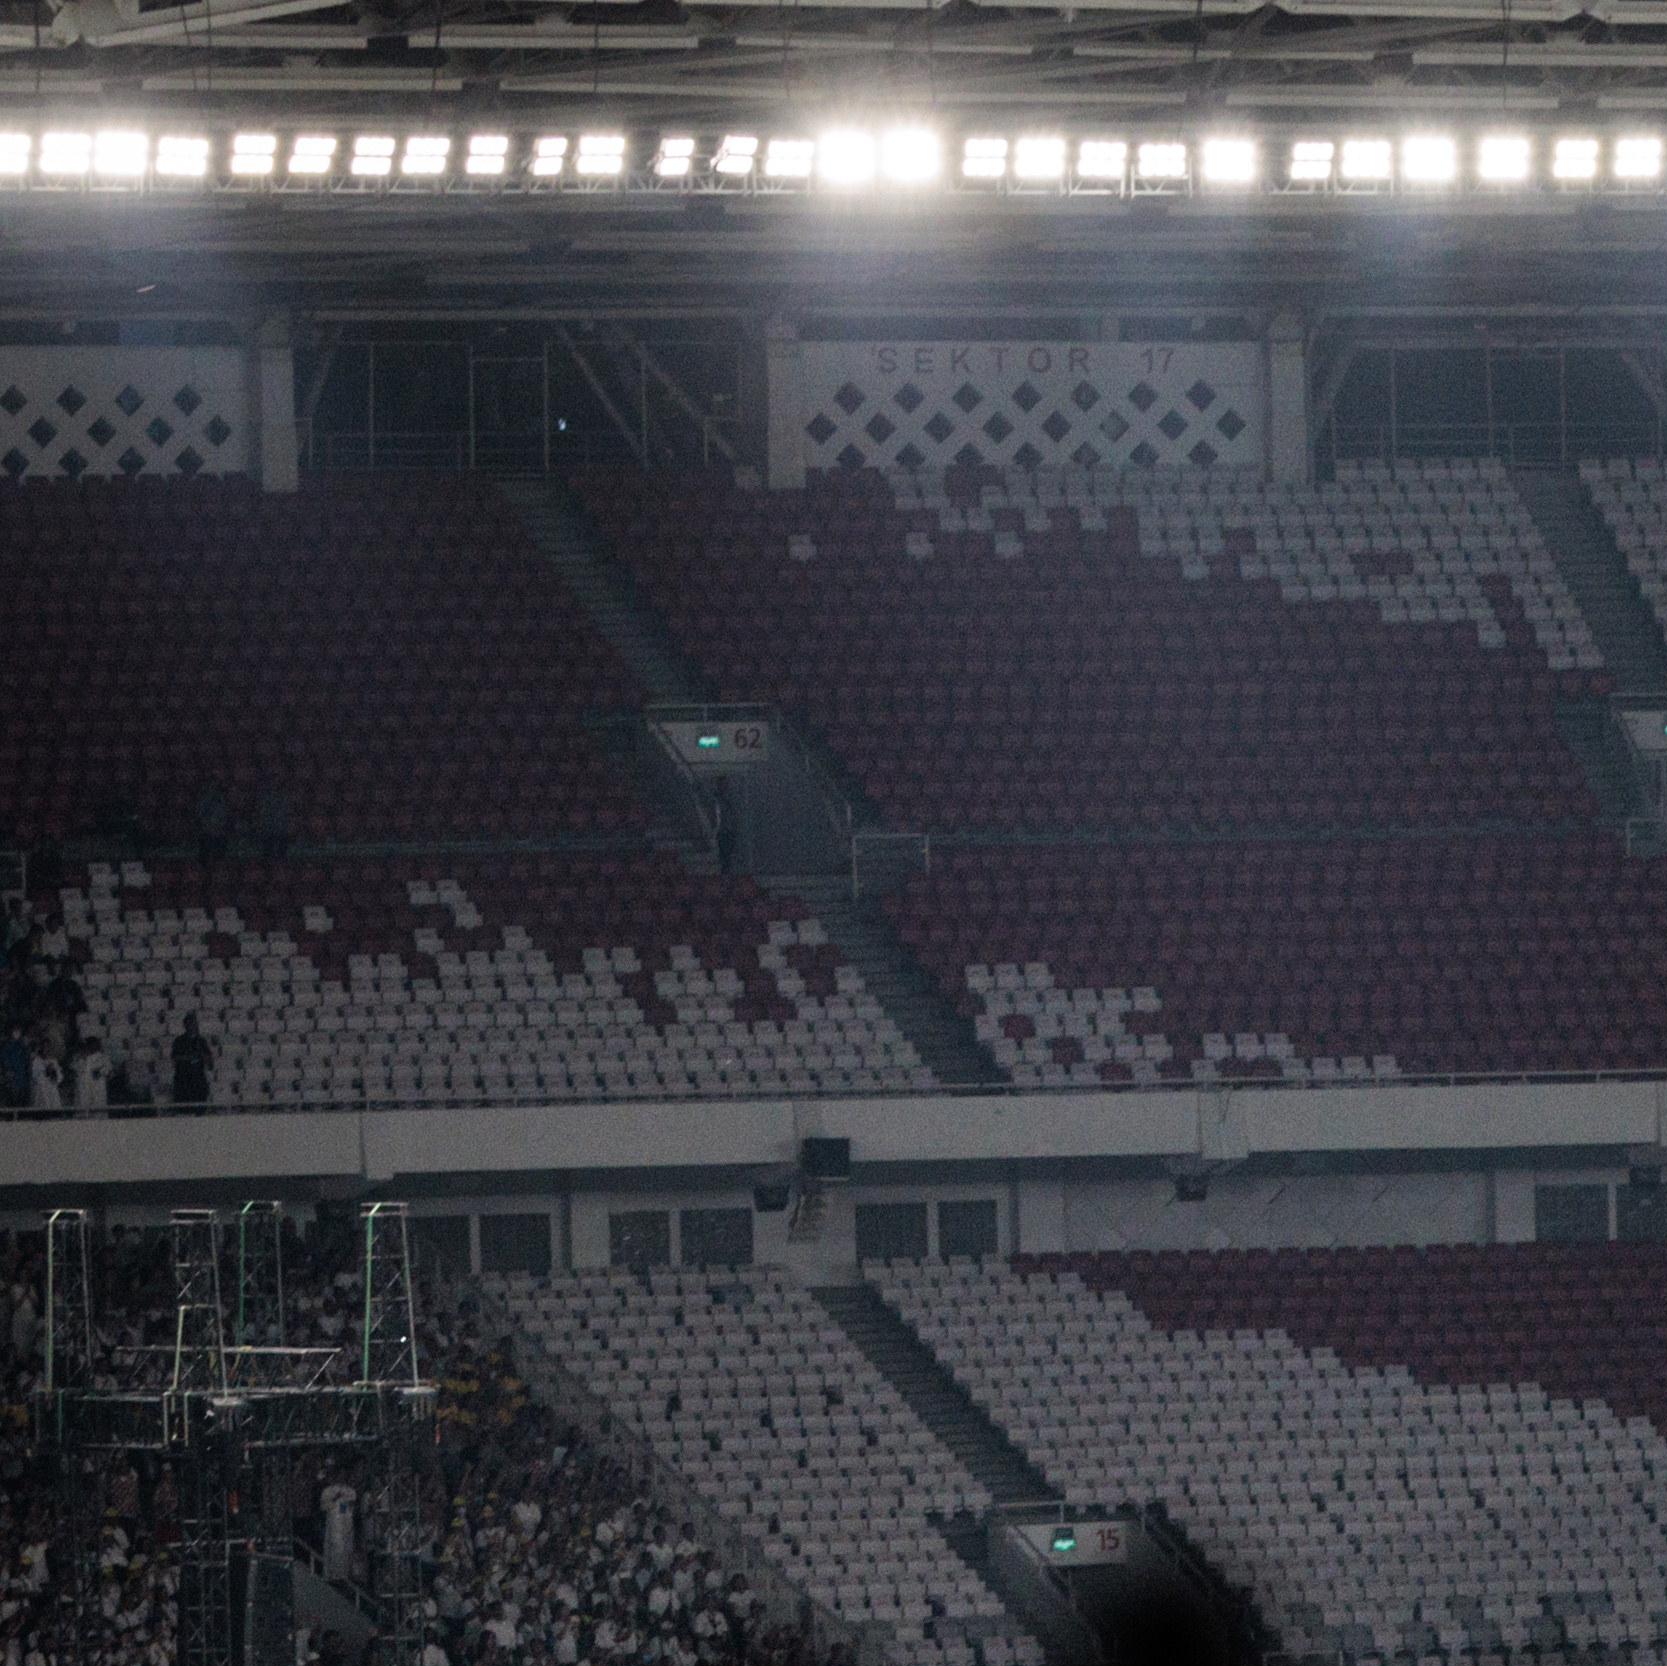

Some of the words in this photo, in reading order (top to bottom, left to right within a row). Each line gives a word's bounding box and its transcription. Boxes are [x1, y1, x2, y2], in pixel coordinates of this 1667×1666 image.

[877, 346, 1091, 374] SEKTOR
[1140, 347, 1176, 373] 17
[733, 727, 763, 749] 62
[1095, 1528, 1121, 1551] 15
